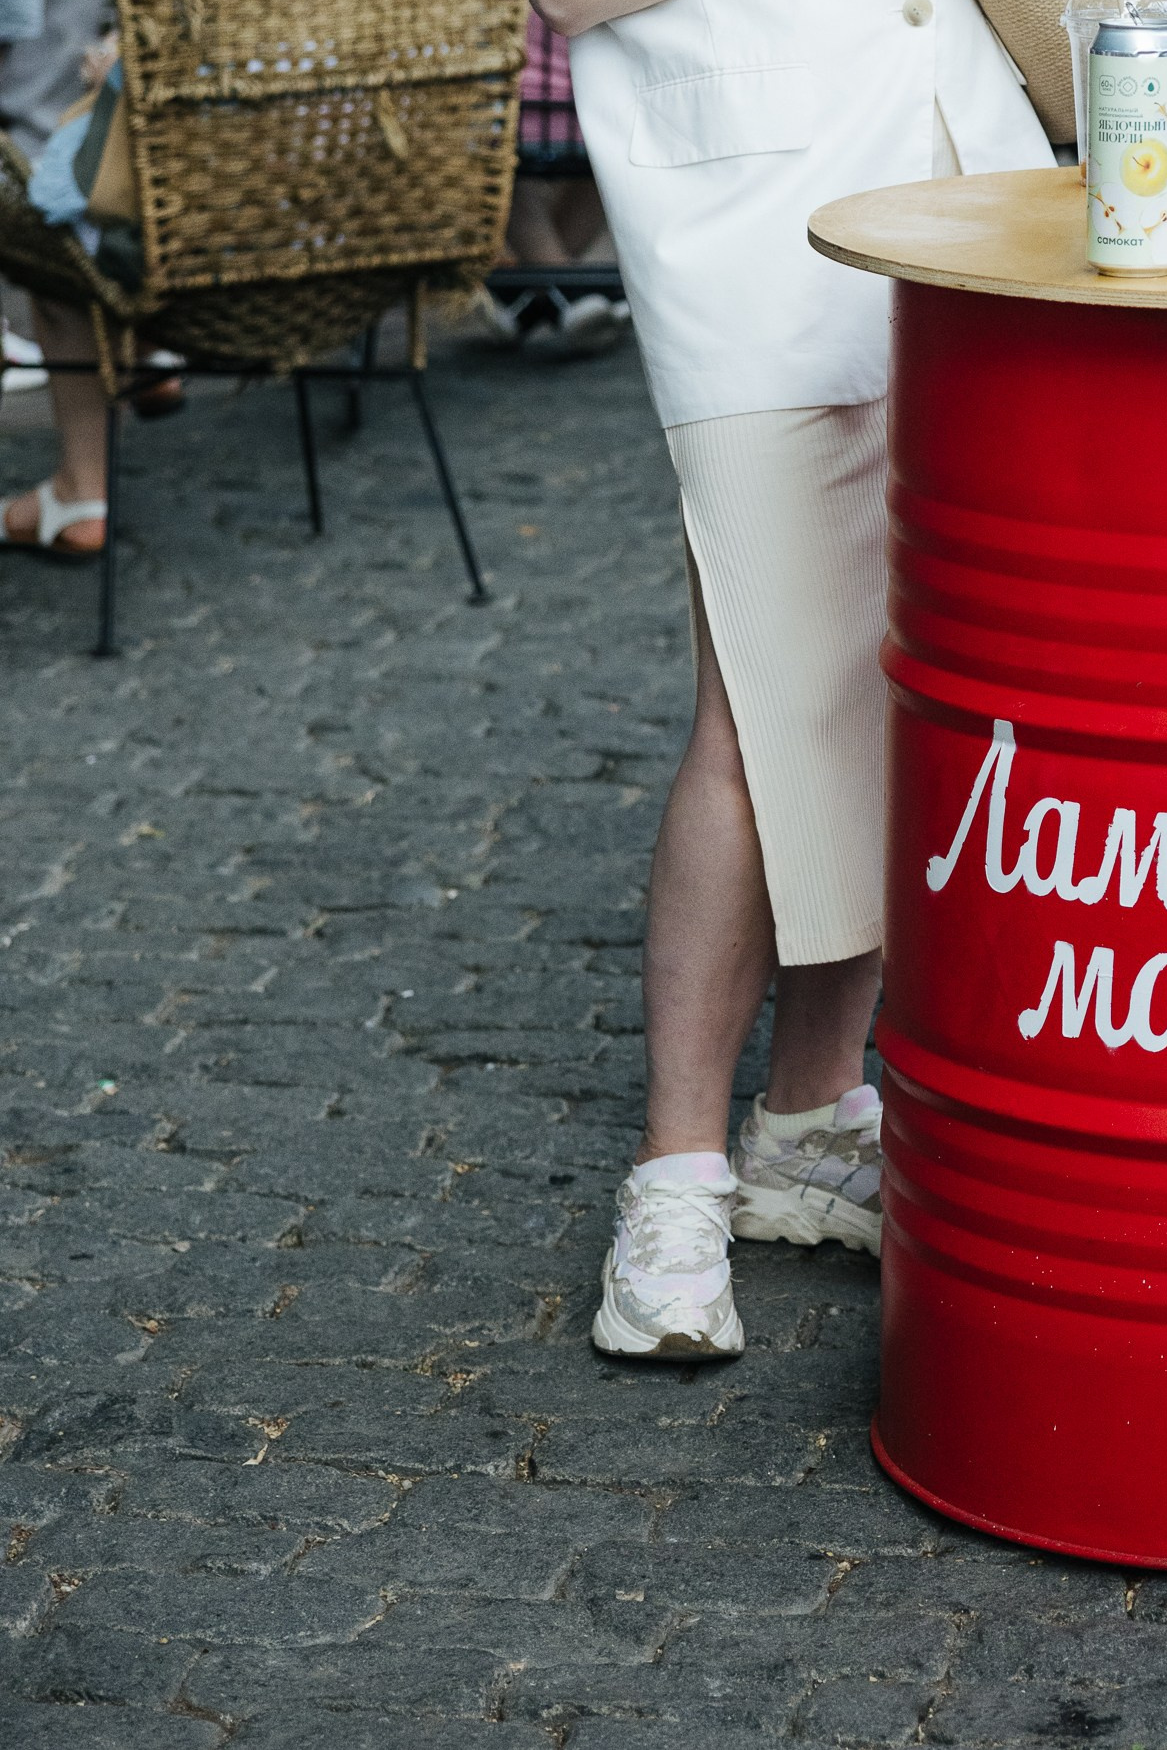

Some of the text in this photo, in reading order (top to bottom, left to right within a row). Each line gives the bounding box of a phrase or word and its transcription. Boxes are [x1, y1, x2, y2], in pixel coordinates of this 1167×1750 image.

[1098, 119, 1166, 131] ЯБЛОЧНЫЙ
[1098, 131, 1143, 144] ШОРЛИ
[1097, 236, 1144, 246] самокат
